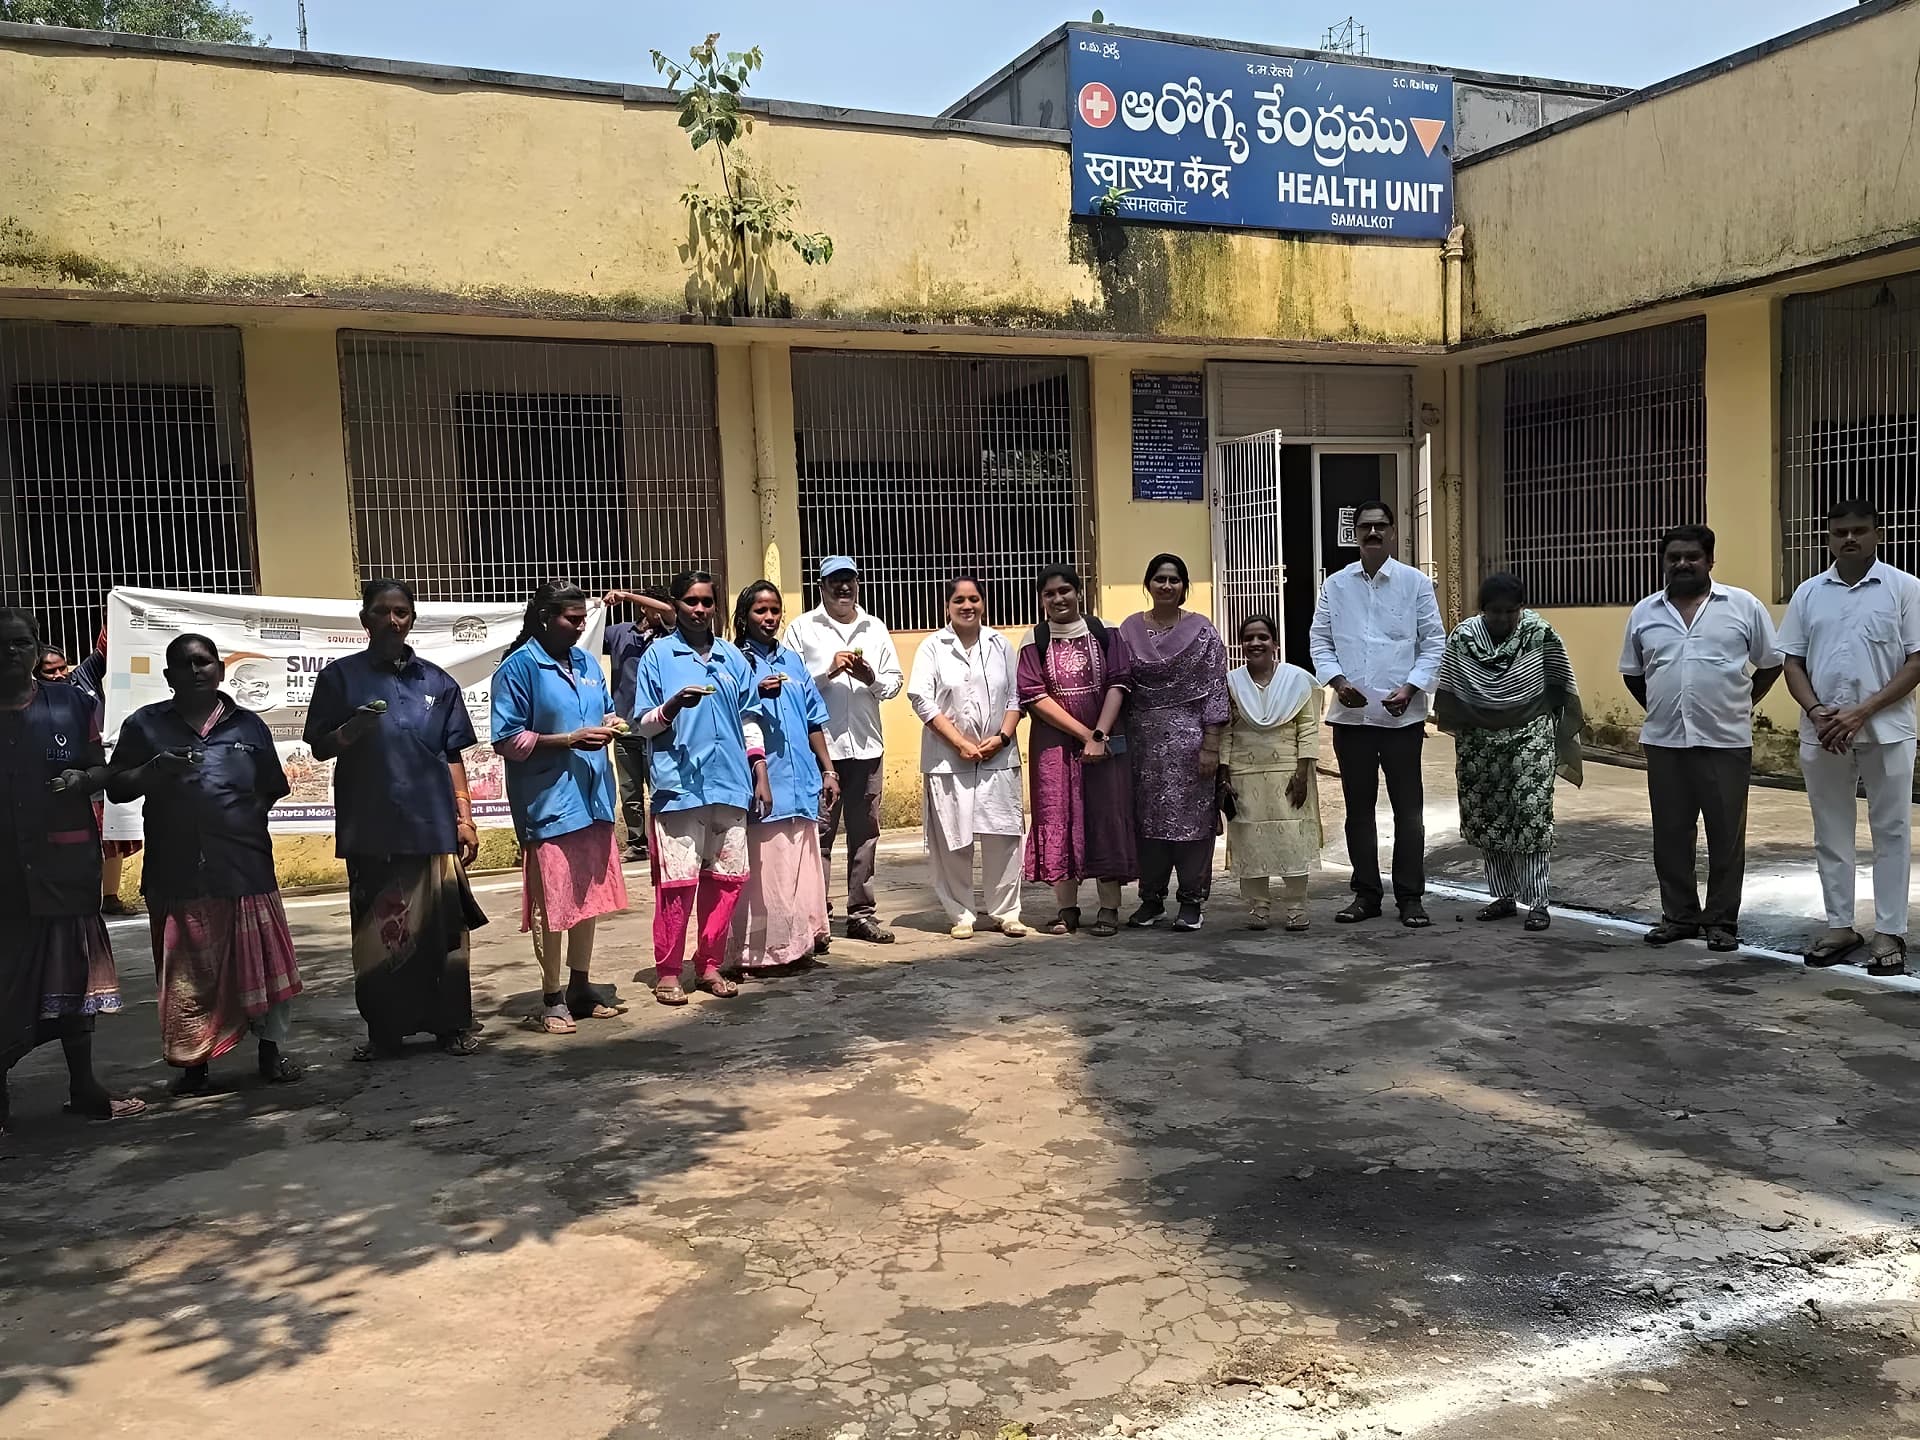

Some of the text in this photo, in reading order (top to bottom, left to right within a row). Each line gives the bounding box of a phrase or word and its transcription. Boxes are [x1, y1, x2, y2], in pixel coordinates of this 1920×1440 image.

[1121, 76, 1408, 167] ఆరోగ్య కేంద్రము
[1083, 152, 1232, 199] स्वास्थ्य केंद्र
[1278, 171, 1444, 214] HEALTH UNIT
[1331, 212, 1395, 230] SAMALKOT
[286, 674, 304, 688] HI
